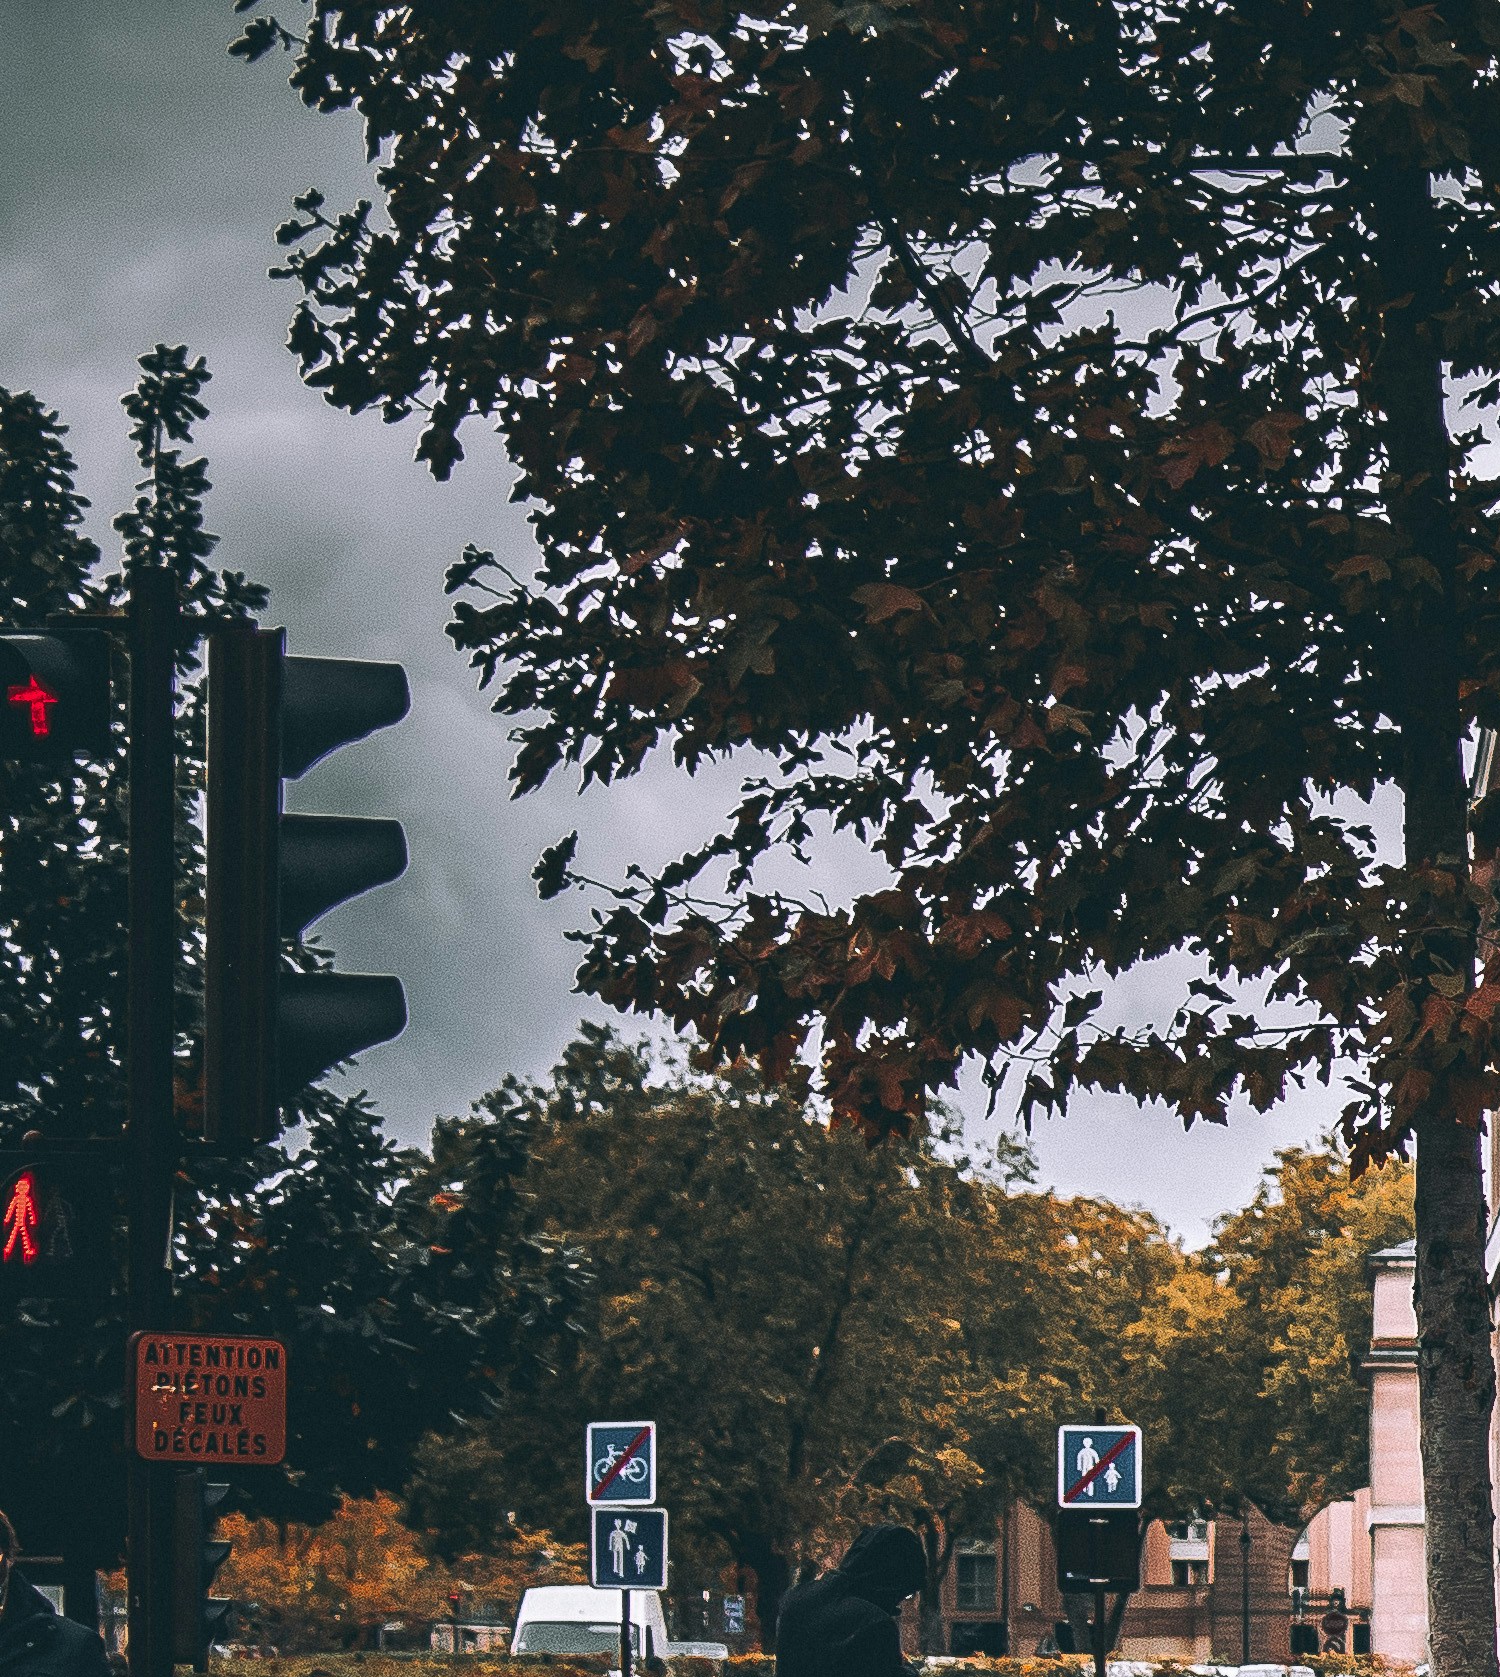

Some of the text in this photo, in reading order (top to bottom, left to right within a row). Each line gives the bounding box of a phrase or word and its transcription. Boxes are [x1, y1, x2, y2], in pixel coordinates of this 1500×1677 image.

[145, 1343, 279, 1370] ATTENTION
[180, 1402, 242, 1425] FEUX
[155, 1427, 267, 1455] DÉCALÉS
